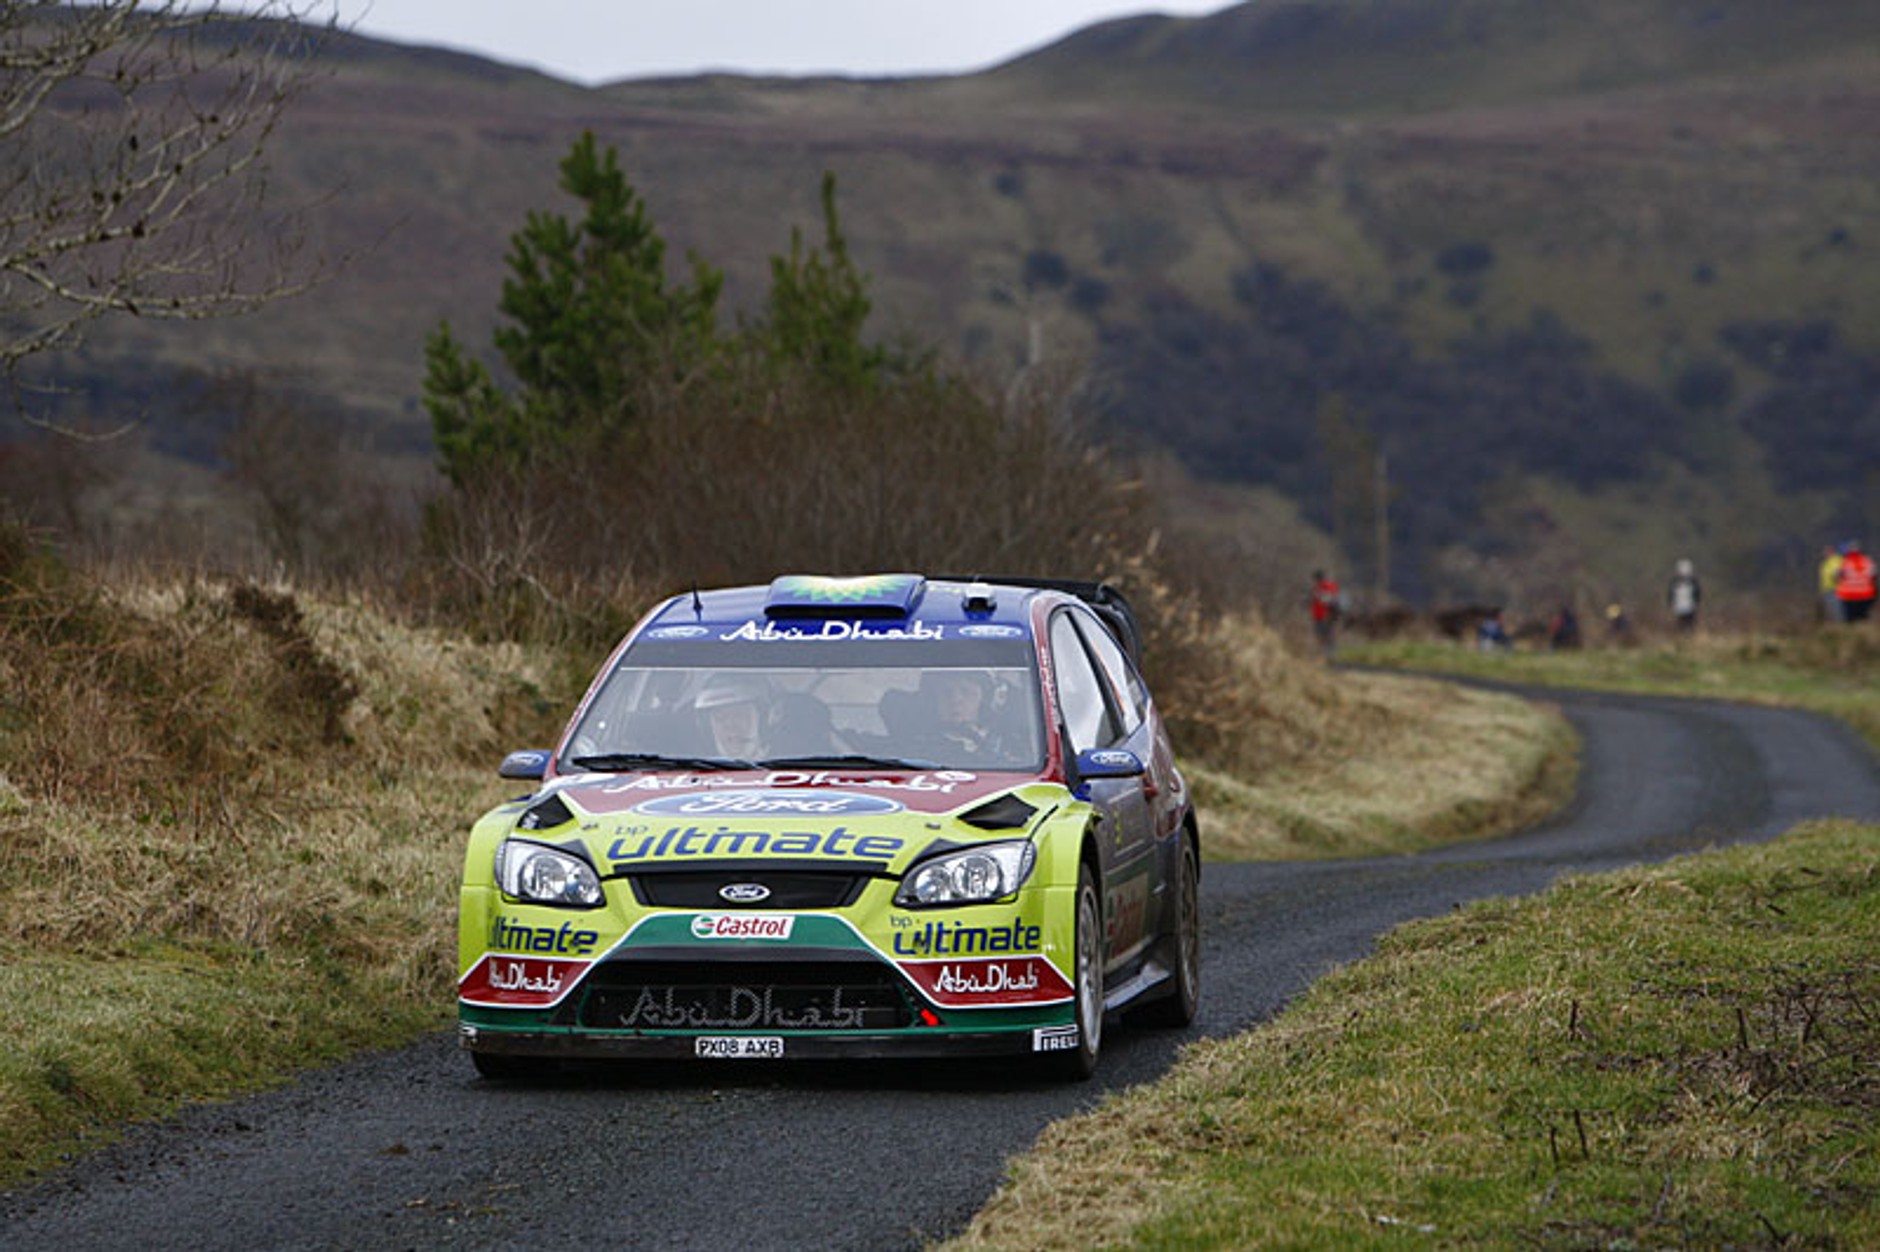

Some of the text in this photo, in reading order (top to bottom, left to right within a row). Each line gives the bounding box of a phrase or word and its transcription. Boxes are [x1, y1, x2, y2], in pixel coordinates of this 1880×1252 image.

[679, 793, 853, 812] Ford
[607, 826, 904, 860] ultimate
[716, 916, 787, 936] Castrol
[889, 914, 912, 928] bp
[488, 915, 598, 954] ltimate
[893, 917, 1041, 955] ultimate
[699, 1040, 739, 1053] PX08
